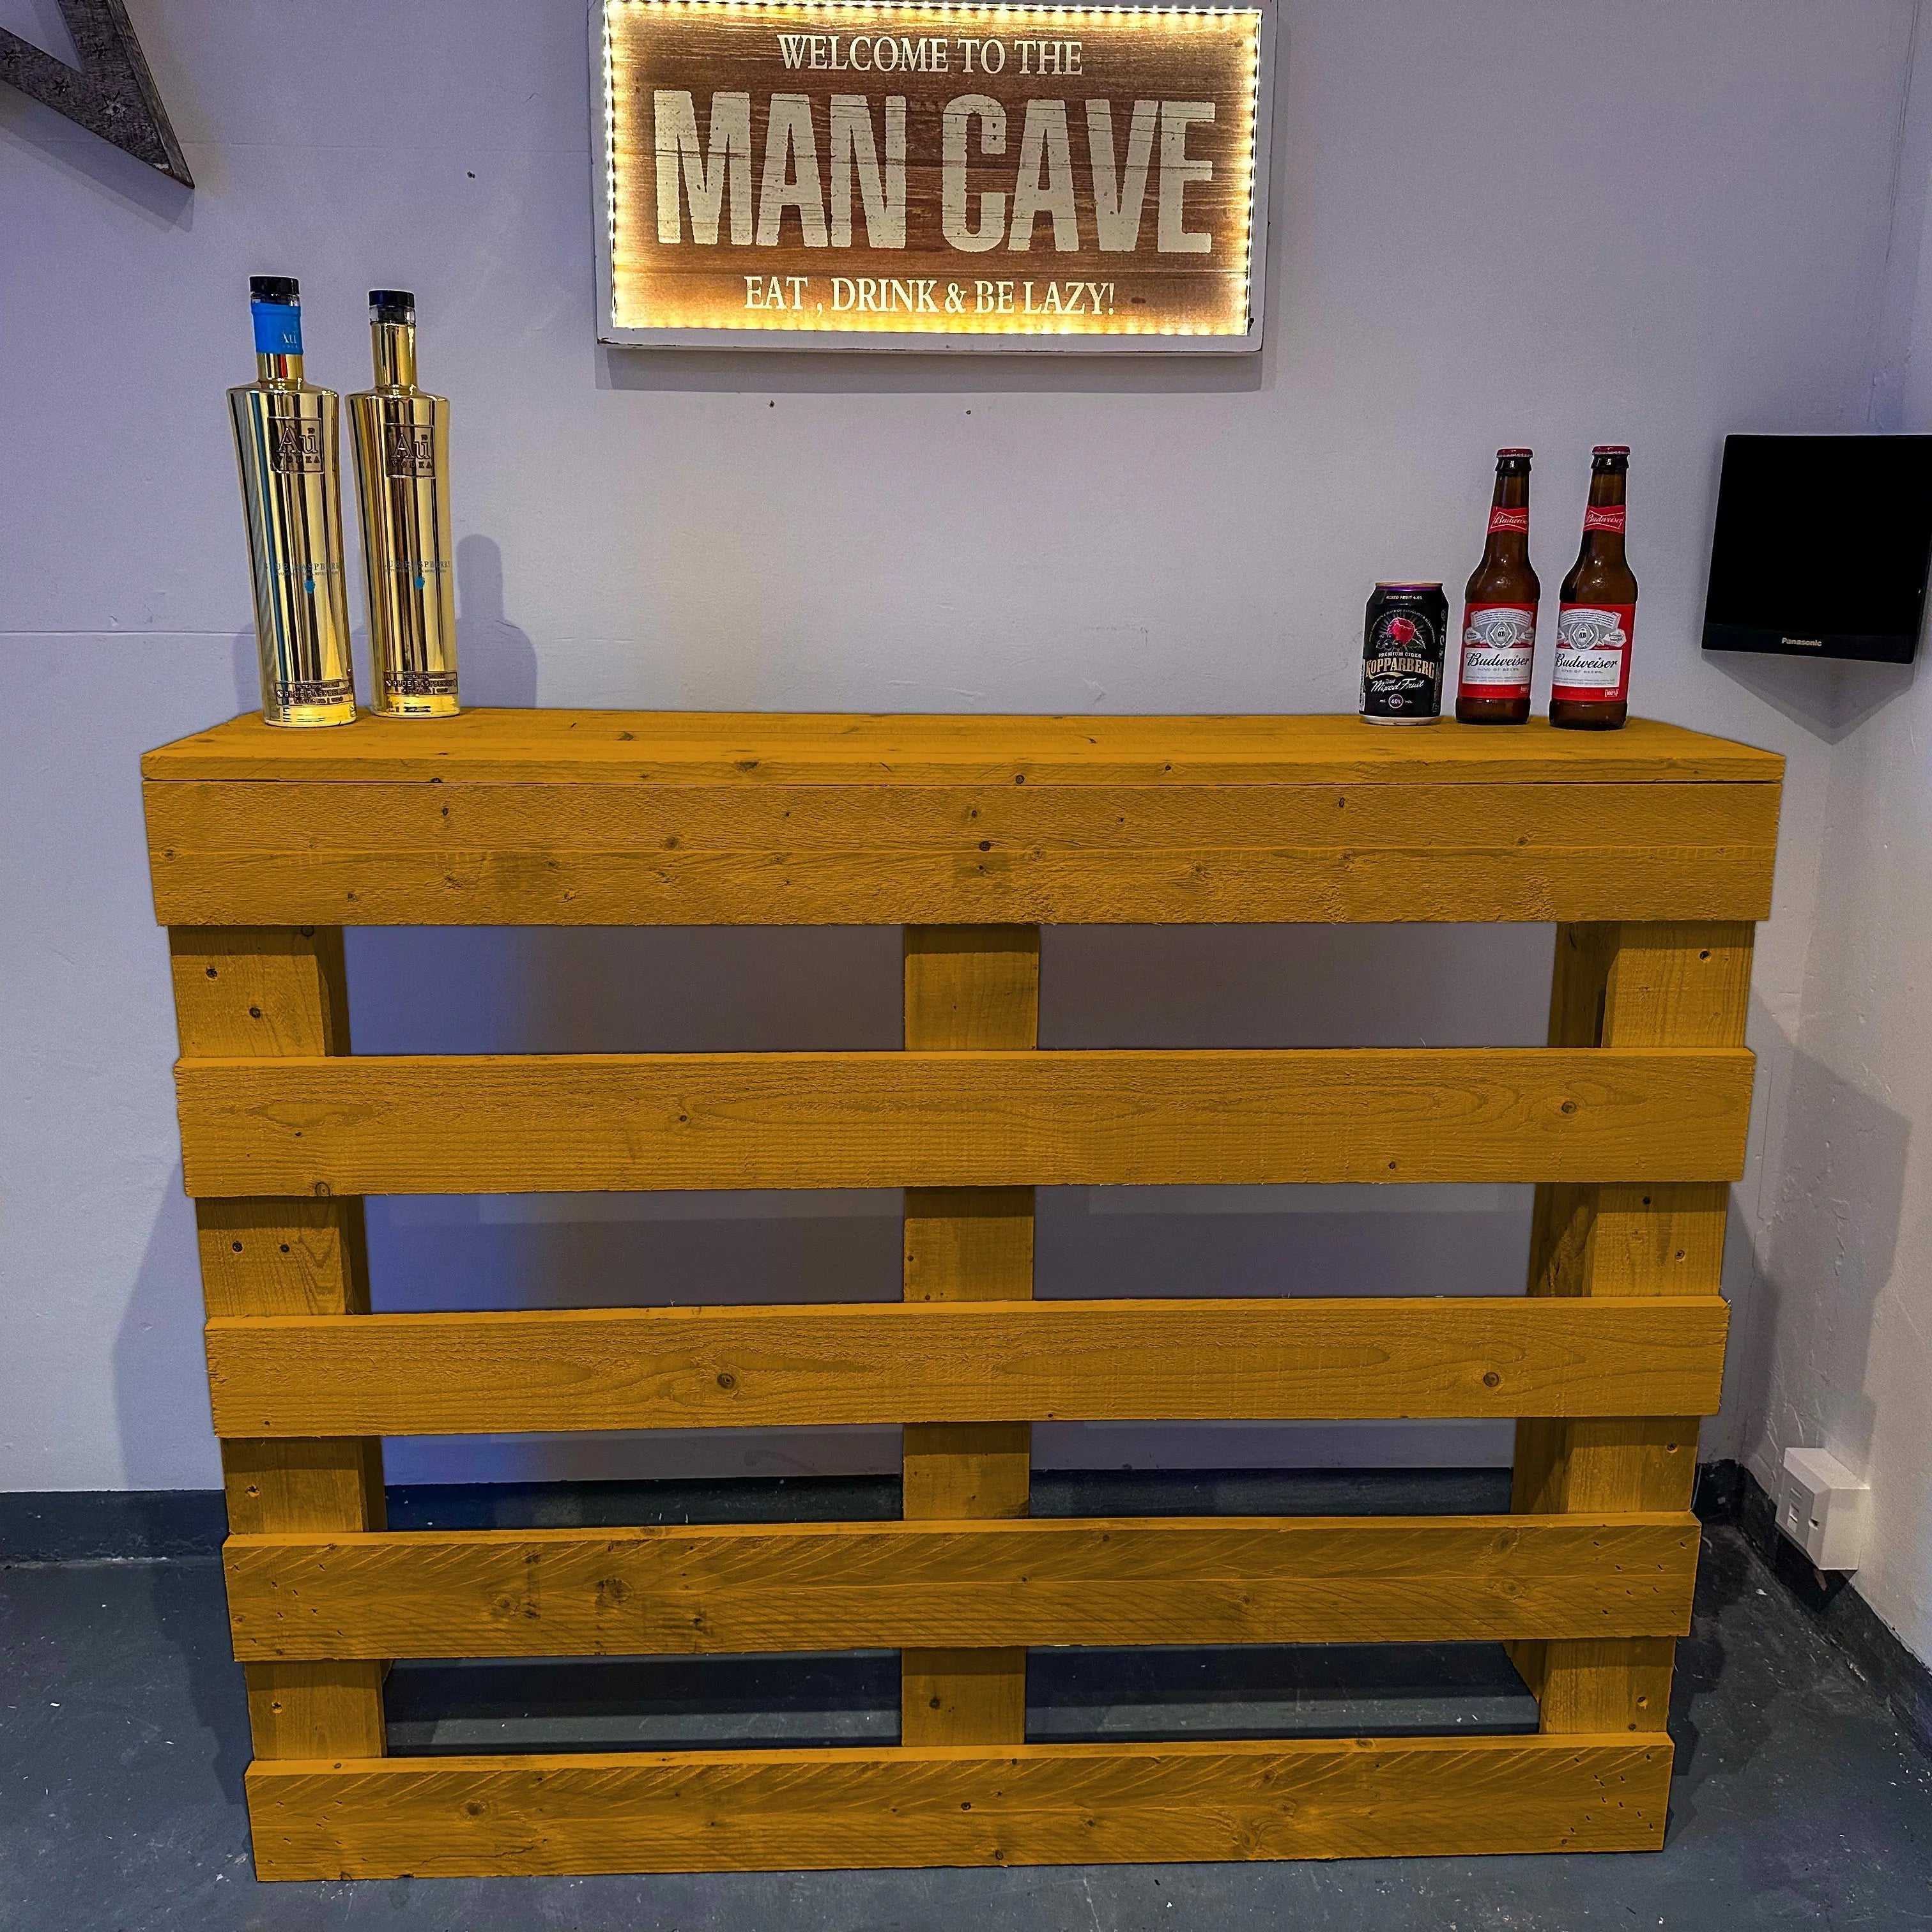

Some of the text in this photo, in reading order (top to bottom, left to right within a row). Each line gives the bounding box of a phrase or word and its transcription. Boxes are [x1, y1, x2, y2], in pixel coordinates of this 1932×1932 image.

[776, 34, 1082, 75] WELCOME TO THE
[654, 89, 1216, 254] MAN CAVE
[831, 277, 938, 314] DRINK
[944, 282, 967, 314] &
[973, 280, 1015, 314] BE
[1022, 281, 1116, 316] LAZY!
[276, 427, 318, 454] Au
[391, 434, 431, 459] Au
[1781, 638, 1822, 647] Panasonic
[1365, 657, 1435, 680] KOPPARBERG
[1466, 652, 1530, 667] Budweiser
[1555, 653, 1618, 668] Budweiser
[1370, 677, 1425, 693] Mixed Fruit
